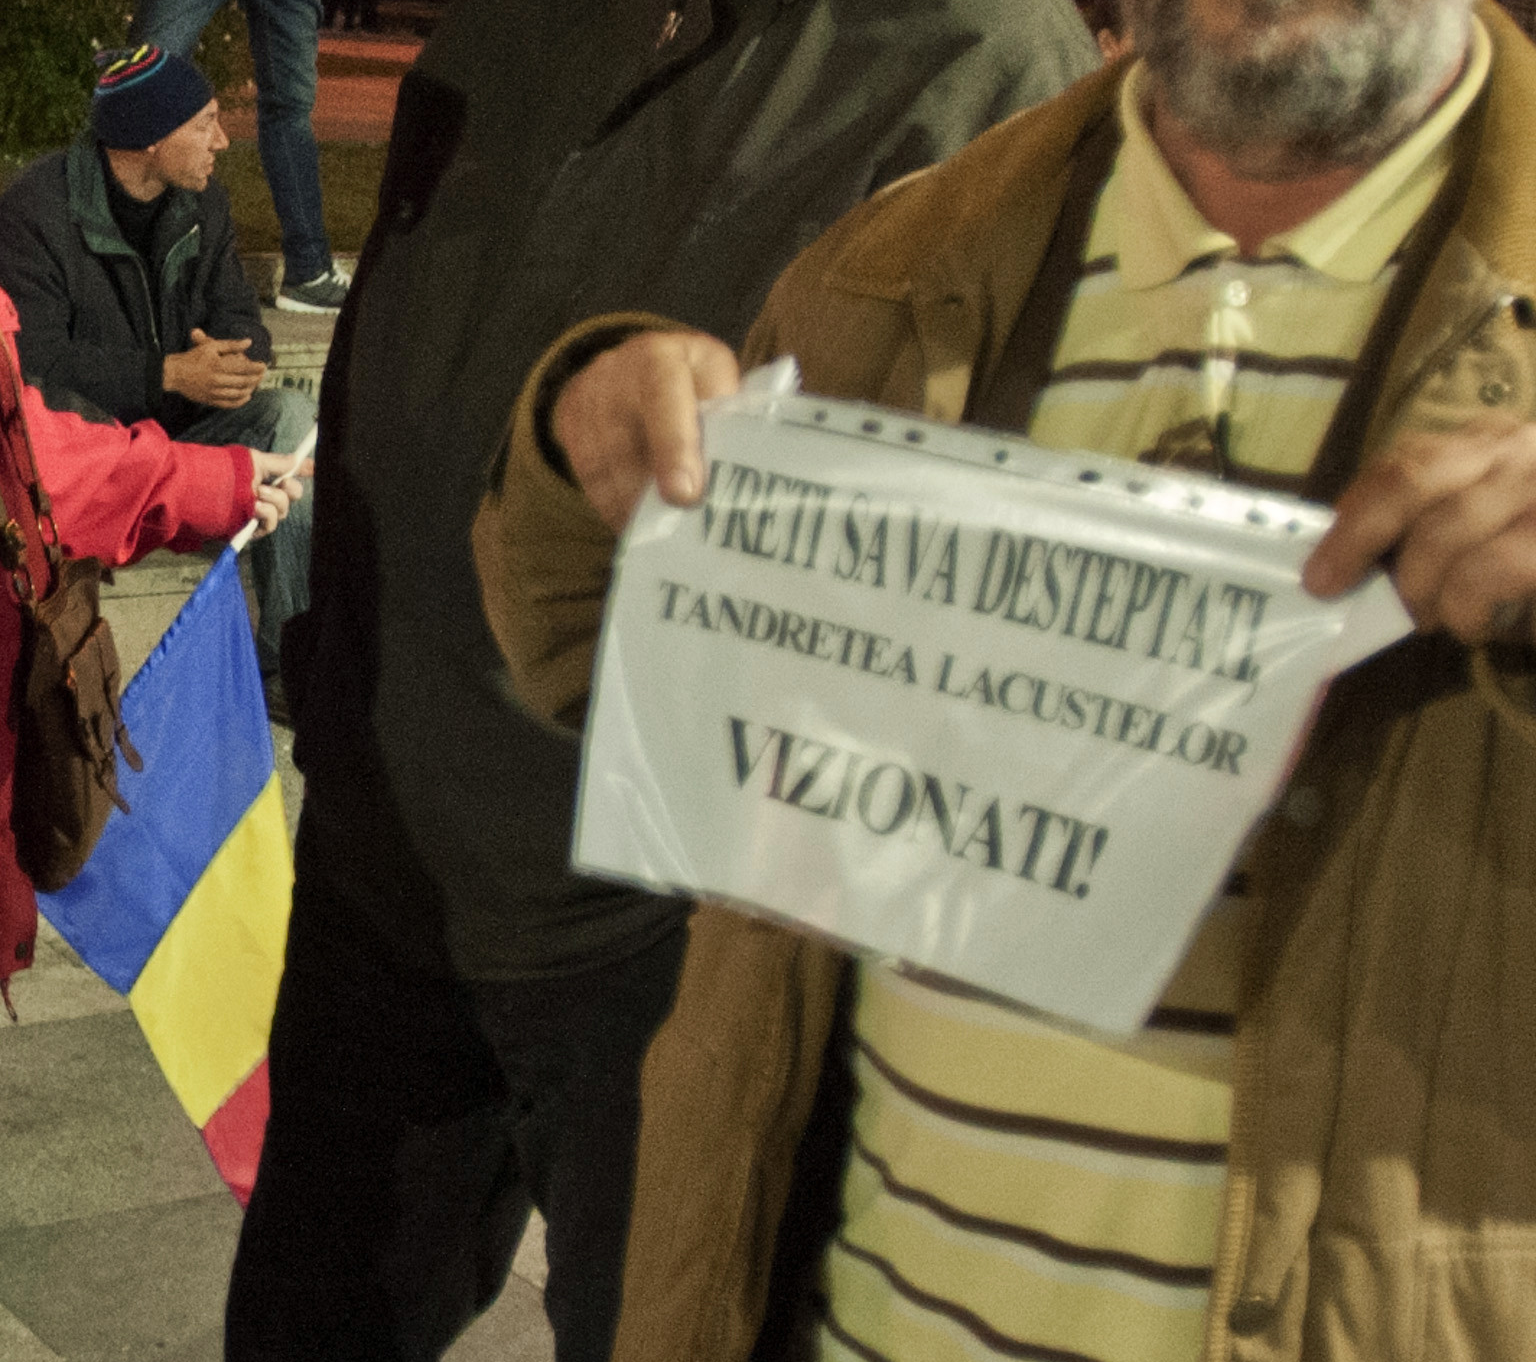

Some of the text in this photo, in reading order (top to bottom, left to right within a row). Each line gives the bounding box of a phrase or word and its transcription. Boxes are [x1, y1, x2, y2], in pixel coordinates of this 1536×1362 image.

[702, 459, 833, 571] VRETI
[659, 579, 1249, 776] TANDRETEA LACUSTELOR
[725, 715, 1110, 899] VIZIONATI!
